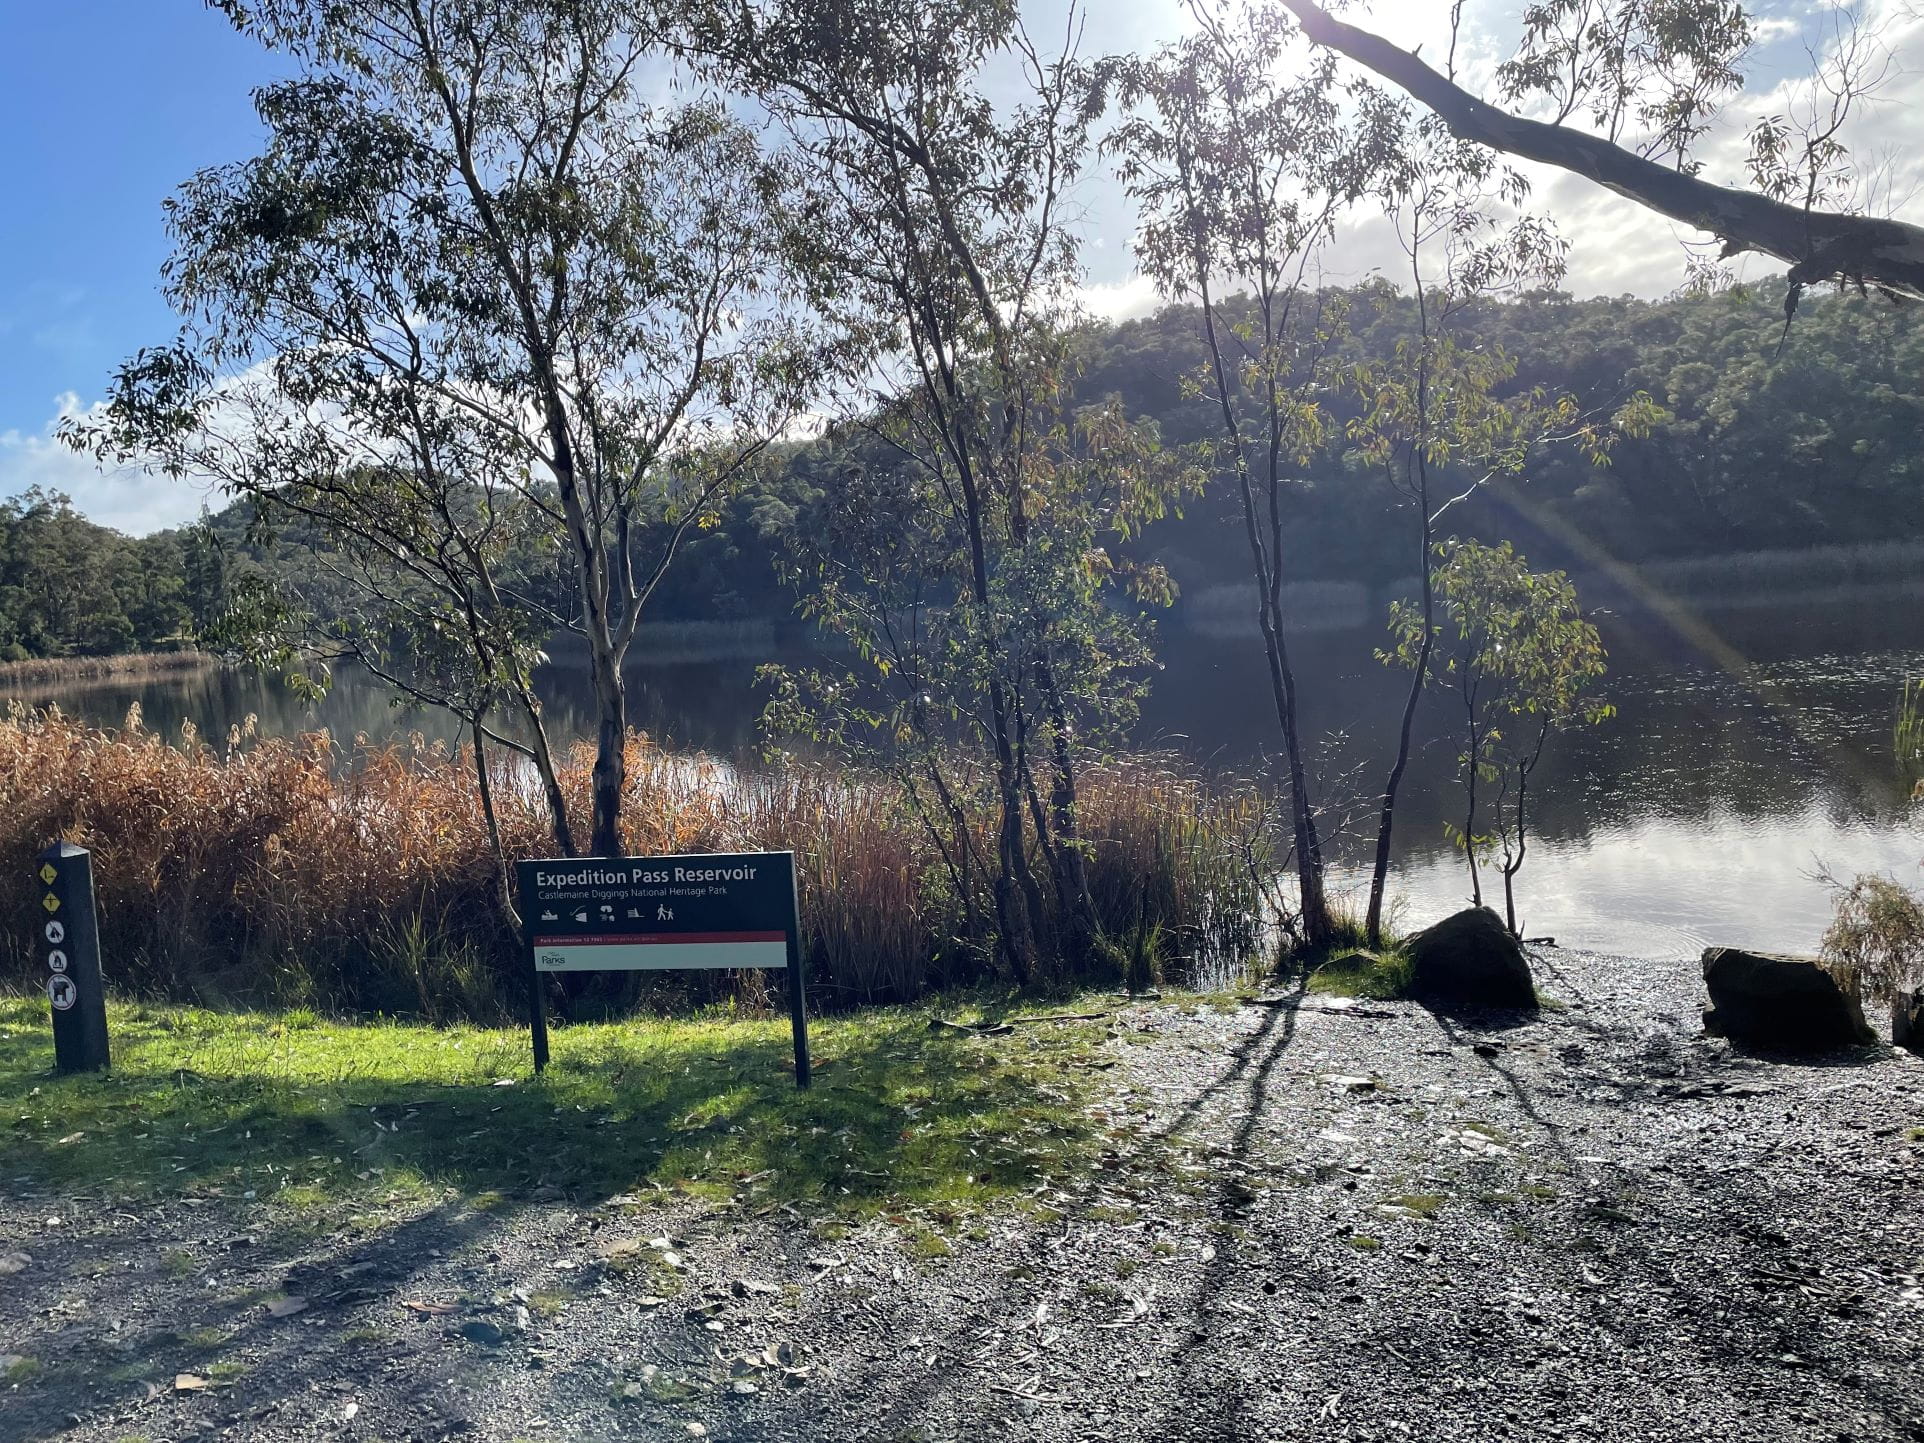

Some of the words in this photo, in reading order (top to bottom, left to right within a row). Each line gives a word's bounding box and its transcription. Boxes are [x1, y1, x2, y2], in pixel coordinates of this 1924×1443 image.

[537, 870, 627, 889] Expedition
[632, 869, 669, 883] Pass
[674, 865, 757, 882] Reservoir
[538, 890, 590, 899] Castlemaine
[592, 889, 629, 900] Diggings
[631, 888, 667, 897] National
[669, 887, 706, 897] Heritage
[708, 886, 727, 895] Park
[541, 955, 566, 964] Parks
